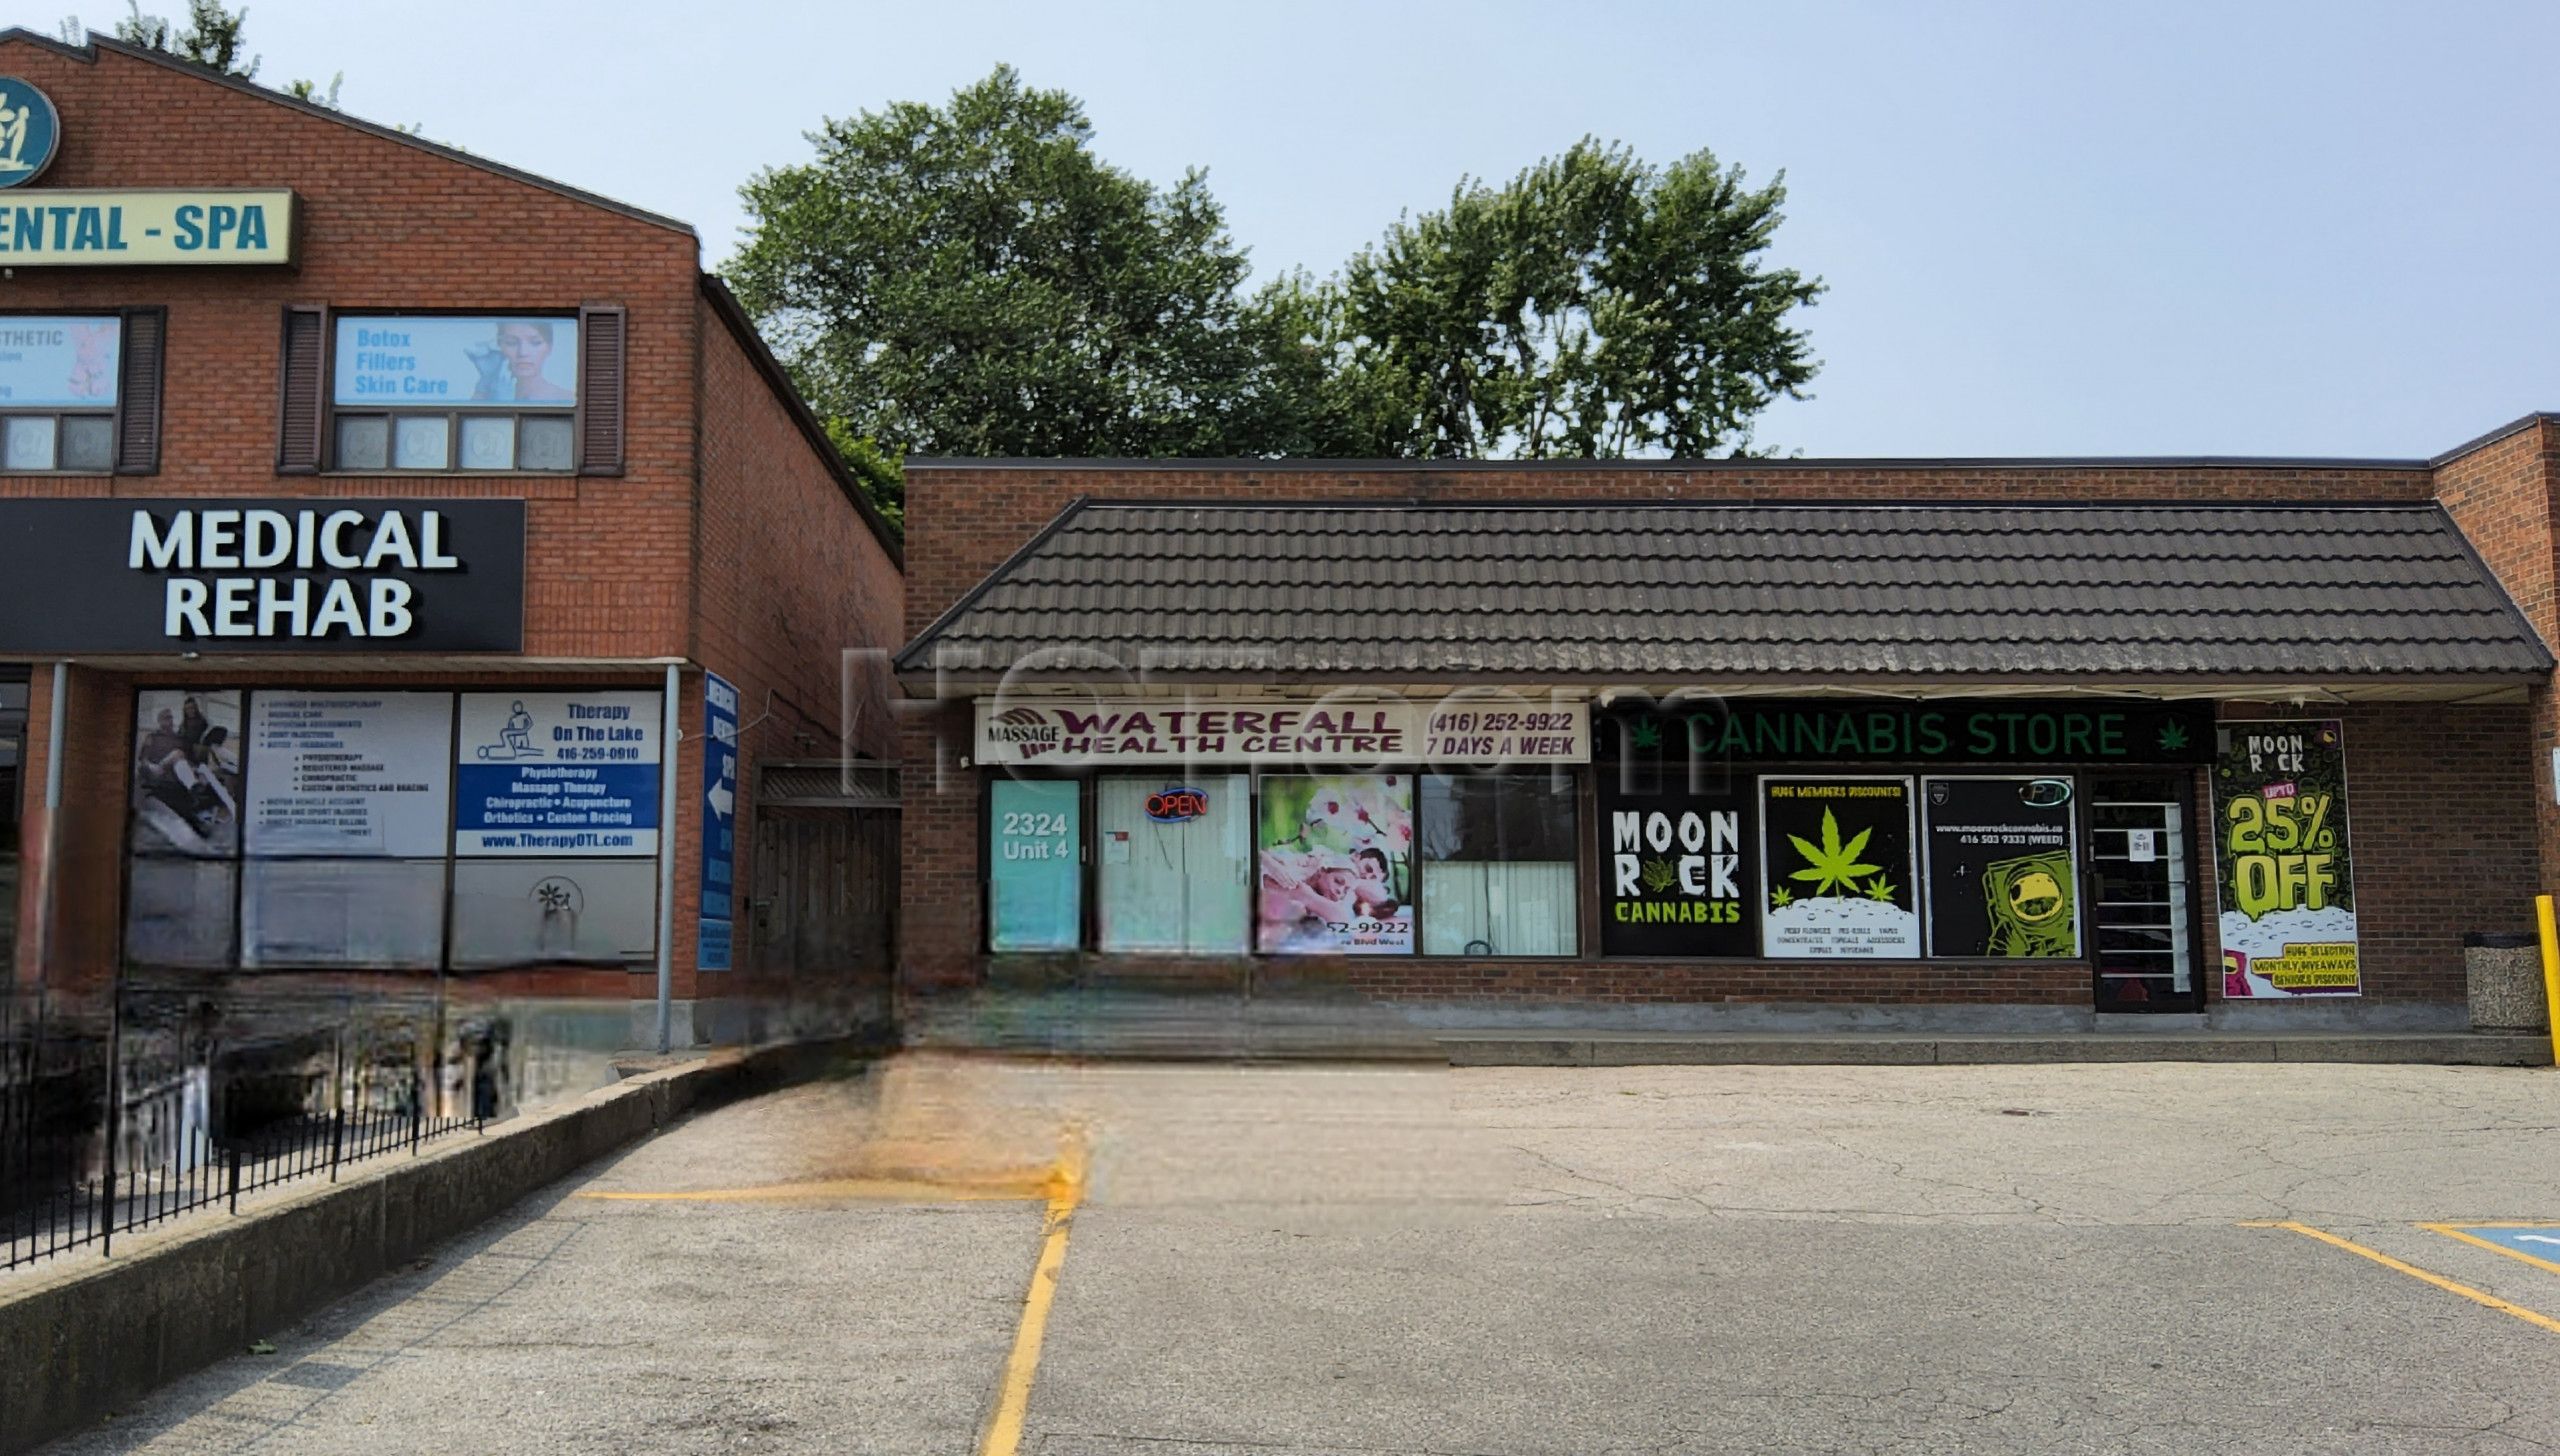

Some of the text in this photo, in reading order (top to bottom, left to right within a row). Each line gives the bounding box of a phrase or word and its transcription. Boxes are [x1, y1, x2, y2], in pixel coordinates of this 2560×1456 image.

[174, 205, 268, 250] SPA
[0, 330, 64, 346] THETIC
[357, 328, 411, 347] Botox
[356, 352, 416, 371] Fillers
[355, 375, 448, 394] Skin Care
[129, 509, 458, 569] MEDICAL
[165, 577, 413, 637] REHAB
[567, 703, 631, 720] Therapy
[1051, 709, 1403, 735] WATERFALL
[1428, 712, 1573, 734] (416) 252-9922
[553, 726, 643, 741] On The Lake
[987, 726, 1060, 742] MASSAGE
[1691, 713, 2127, 755] CANNABIS STORE
[557, 748, 639, 759] 416-259-0910
[1062, 735, 1403, 753] HEALTH CENTRE
[1426, 737, 1575, 755] 7 DAYS A WEEK
[2248, 735, 2303, 754] MOON
[521, 767, 598, 780] Physiotherapy
[511, 782, 606, 795] Massage Therapy
[486, 797, 631, 810] Chiropractic Acupuncture
[1144, 792, 1207, 815] OPEN
[484, 812, 632, 825] Orthotics Custom Bracing
[1003, 812, 1068, 836] 2324
[2228, 794, 2335, 856] 25%
[482, 833, 633, 848] www.TherapyOTL.com
[1613, 811, 1739, 853] MOON
[1960, 835, 2063, 846] 416 503 9333 (WEED)
[1003, 839, 1068, 860] Unit 4
[1614, 854, 1740, 898] RCK
[2235, 853, 2336, 922] OFF
[1615, 902, 1740, 923] CANNABIS
